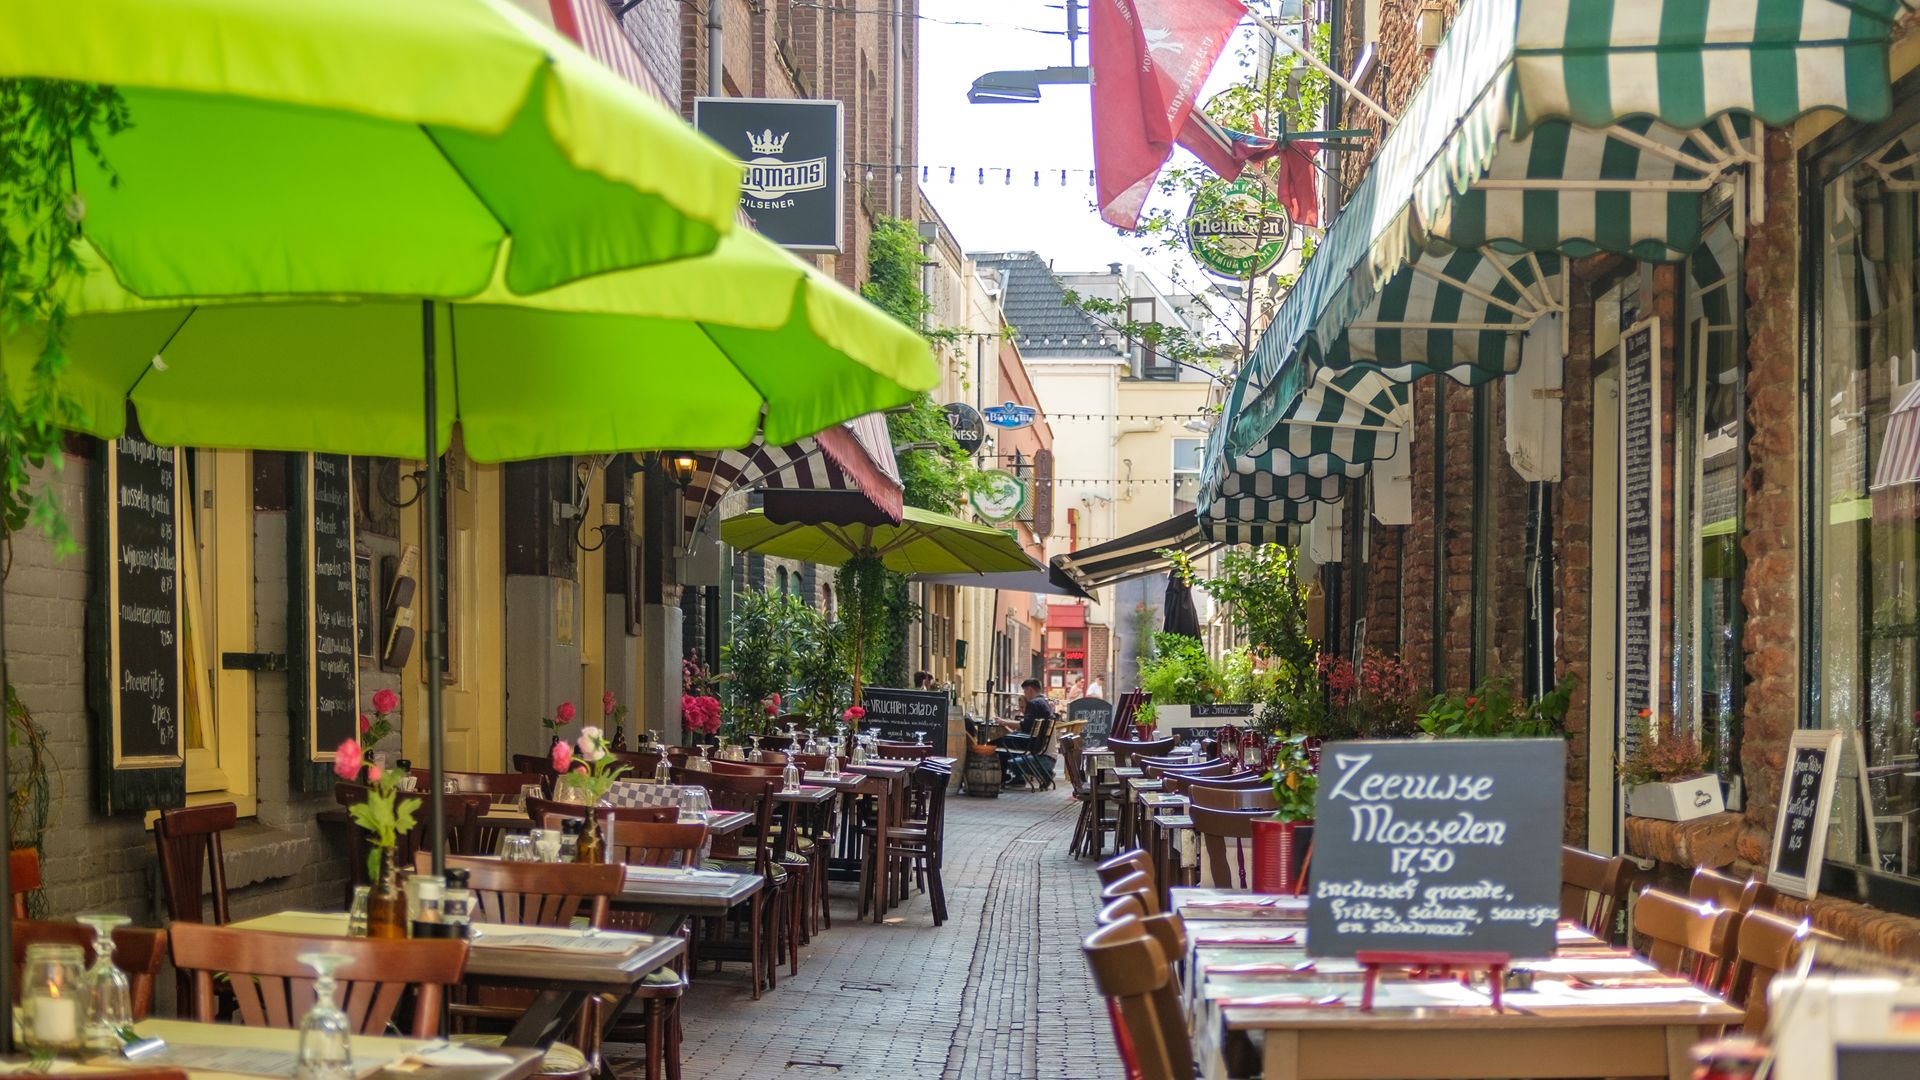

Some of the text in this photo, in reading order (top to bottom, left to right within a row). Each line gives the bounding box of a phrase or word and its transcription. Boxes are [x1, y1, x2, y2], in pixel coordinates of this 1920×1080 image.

[739, 197, 795, 209] PILSENER
[1242, 245, 1274, 269] QULITY
[951, 430, 978, 441] NESS
[1328, 752, 1494, 802] Zeeuwse
[1350, 804, 1507, 846] Mosselen
[1390, 848, 1455, 878] 17,50
[1337, 923, 1366, 934] en
